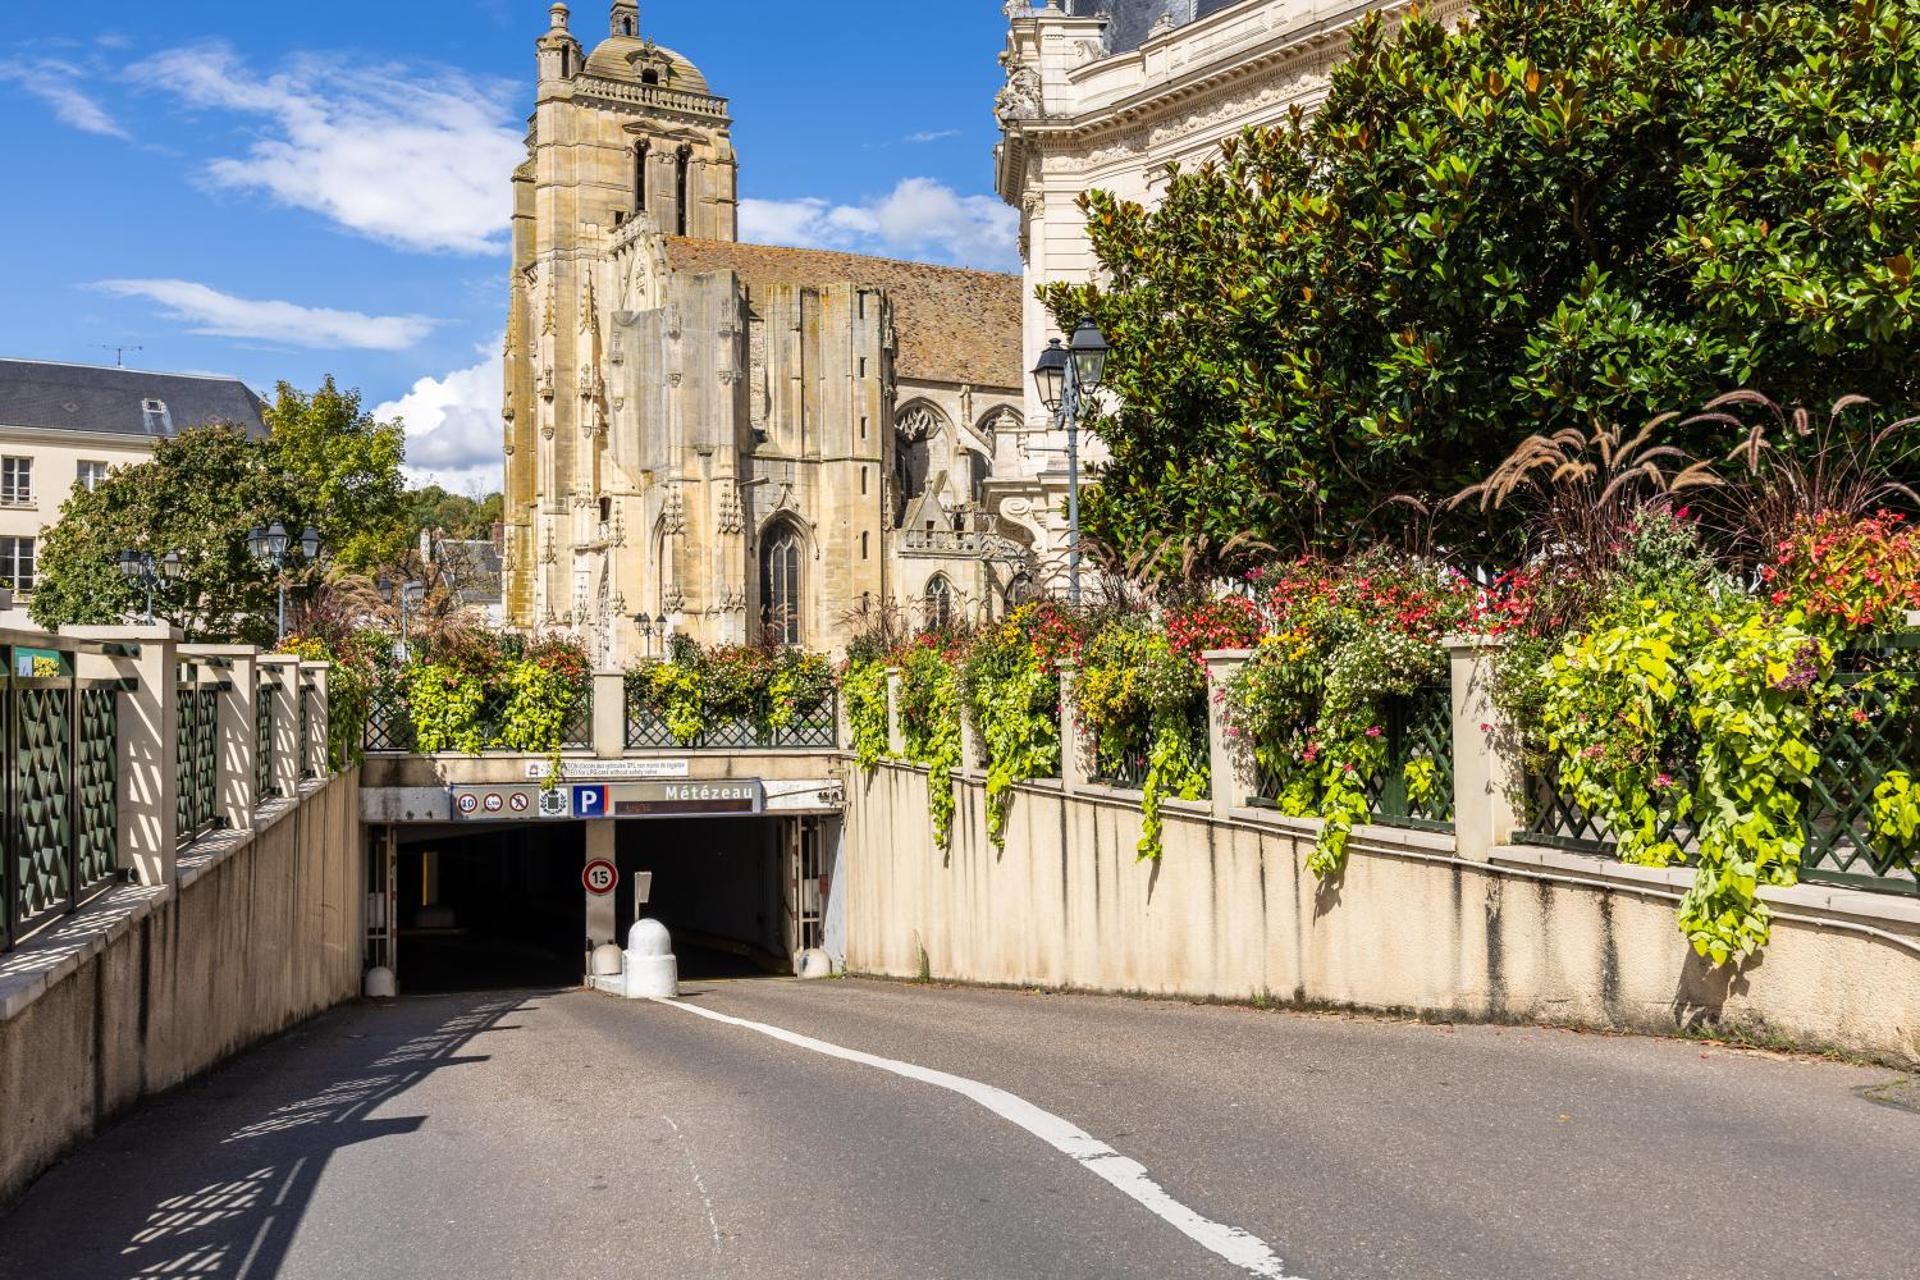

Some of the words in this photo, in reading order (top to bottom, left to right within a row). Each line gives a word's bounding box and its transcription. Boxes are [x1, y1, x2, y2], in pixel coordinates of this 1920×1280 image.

[665, 785, 753, 800] Métézeau
[581, 790, 598, 813] P
[592, 871, 608, 884] 15
